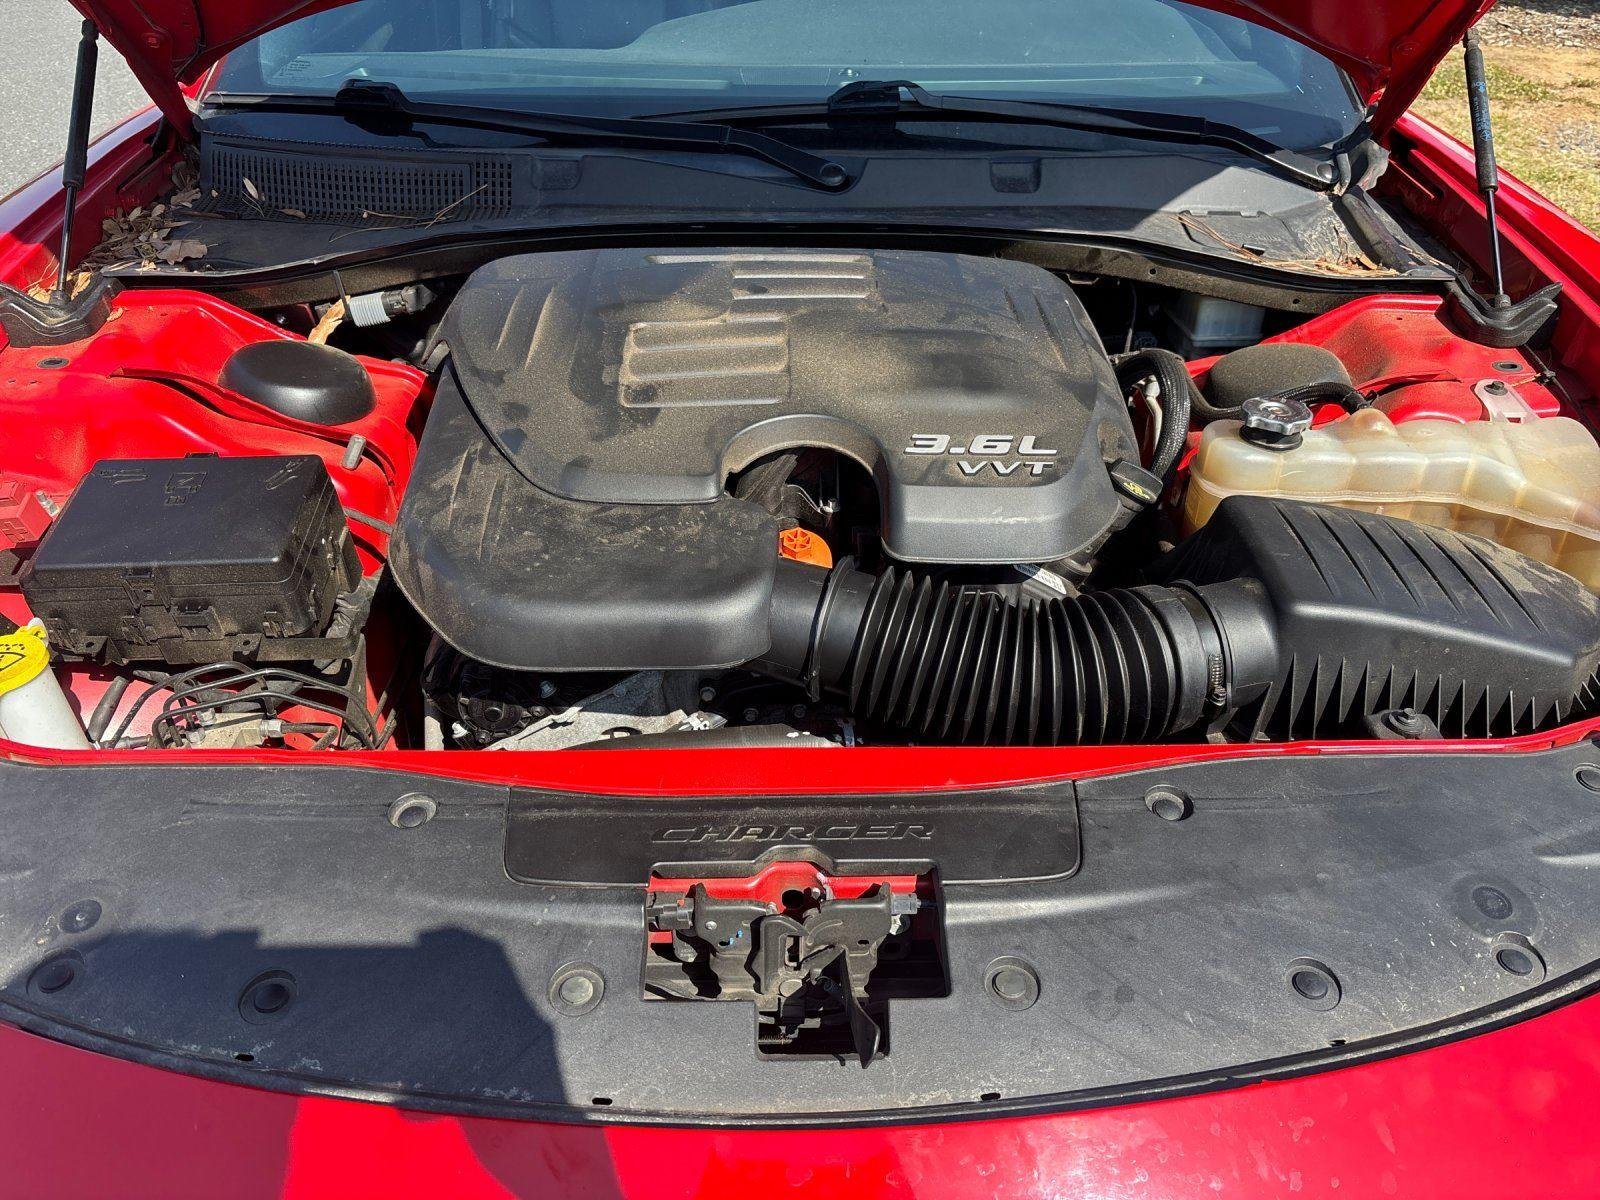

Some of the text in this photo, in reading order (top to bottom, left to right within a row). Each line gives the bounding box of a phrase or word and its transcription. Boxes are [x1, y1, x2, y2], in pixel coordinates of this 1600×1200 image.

[903, 434, 1058, 454] 3.6L
[956, 460, 1055, 477] VVT
[651, 822, 935, 843] CHARGER
